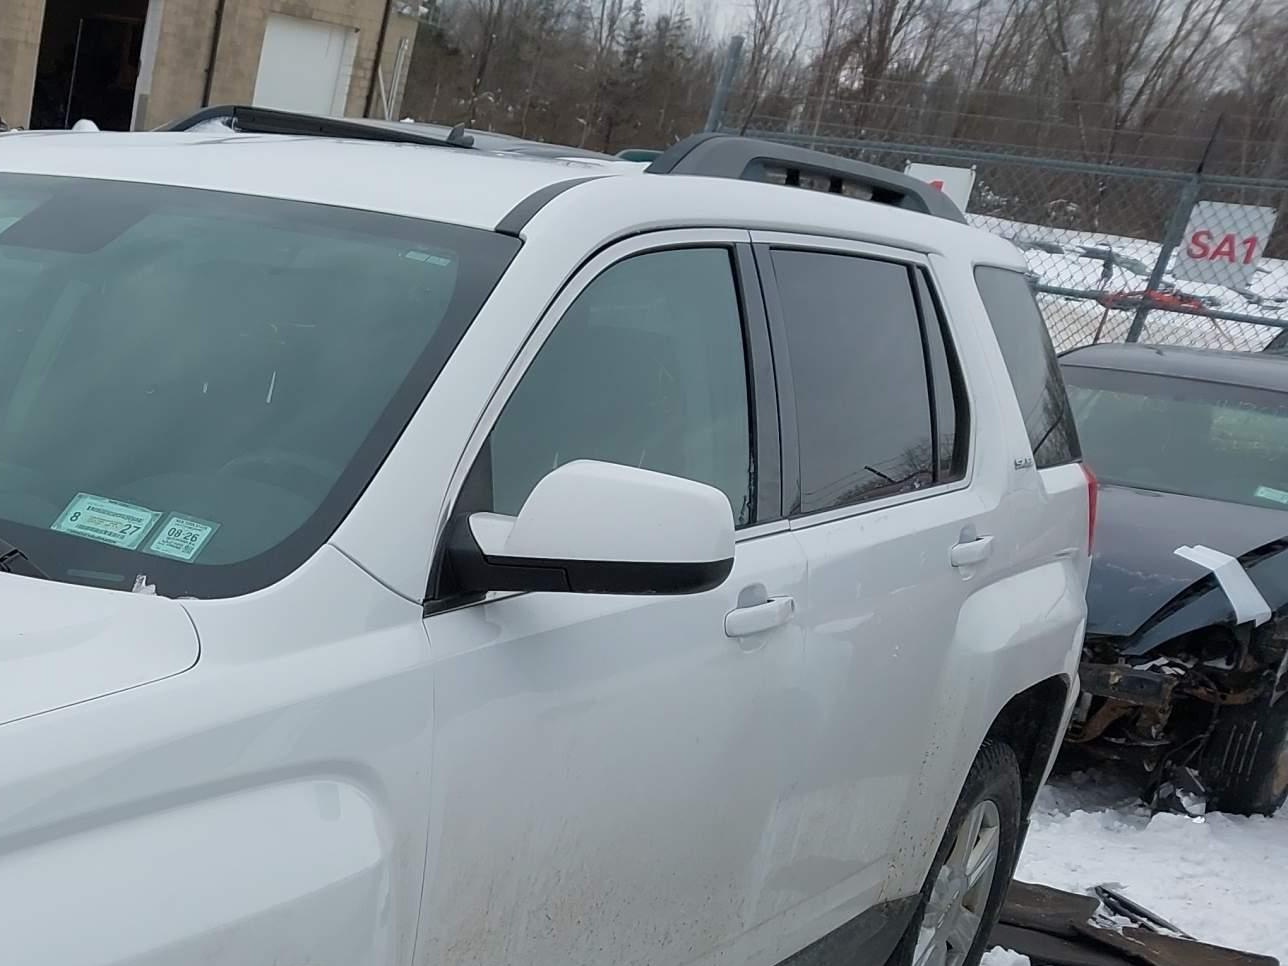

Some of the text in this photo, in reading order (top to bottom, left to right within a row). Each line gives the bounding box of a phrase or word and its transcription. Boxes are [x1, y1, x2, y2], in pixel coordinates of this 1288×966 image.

[1187, 230, 1258, 265] SA1
[70, 511, 82, 522] 8
[119, 523, 142, 536] 27
